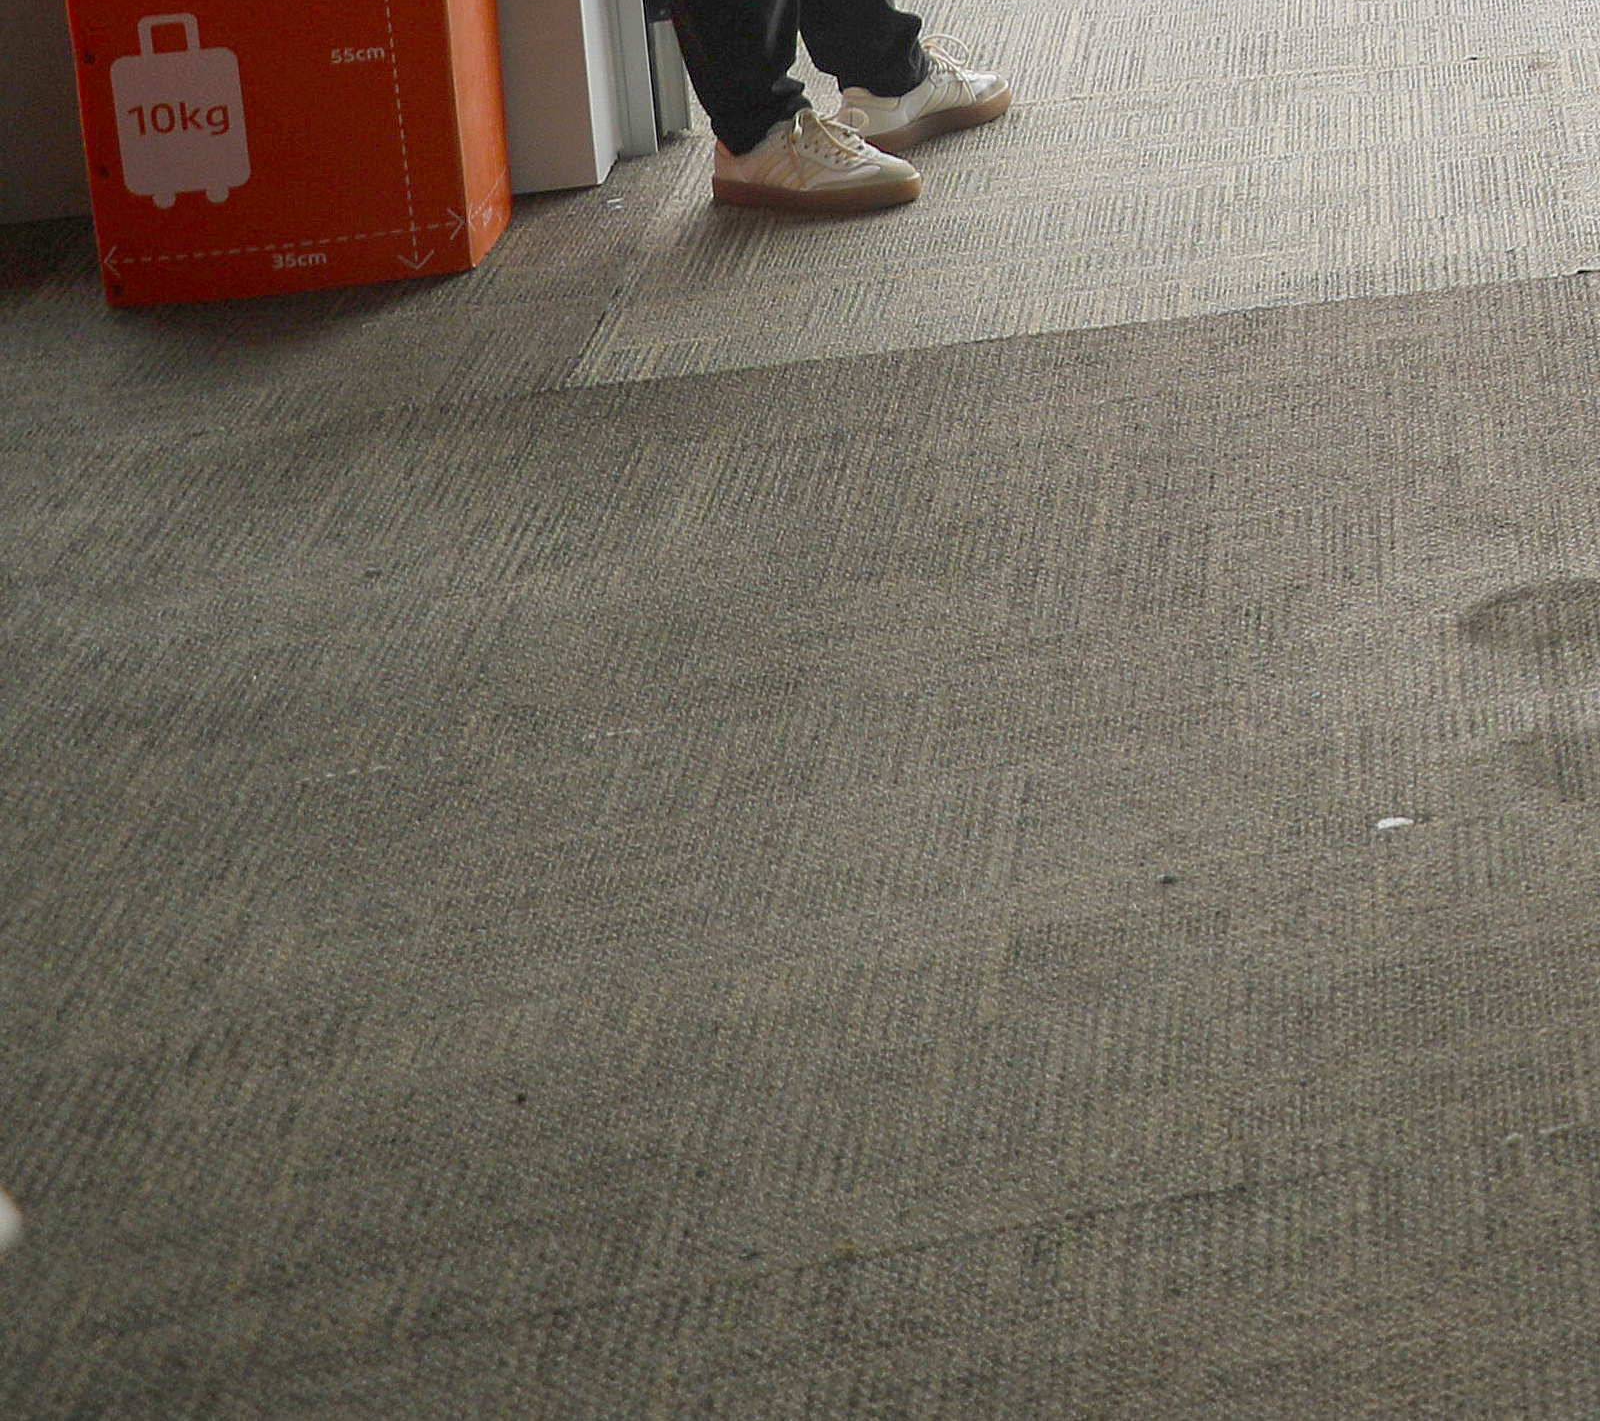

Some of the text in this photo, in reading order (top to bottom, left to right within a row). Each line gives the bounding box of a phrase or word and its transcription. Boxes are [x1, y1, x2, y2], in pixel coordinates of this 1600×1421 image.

[330, 44, 386, 66] 55cm
[128, 100, 231, 138] 10kg
[271, 248, 327, 270] 35cm
